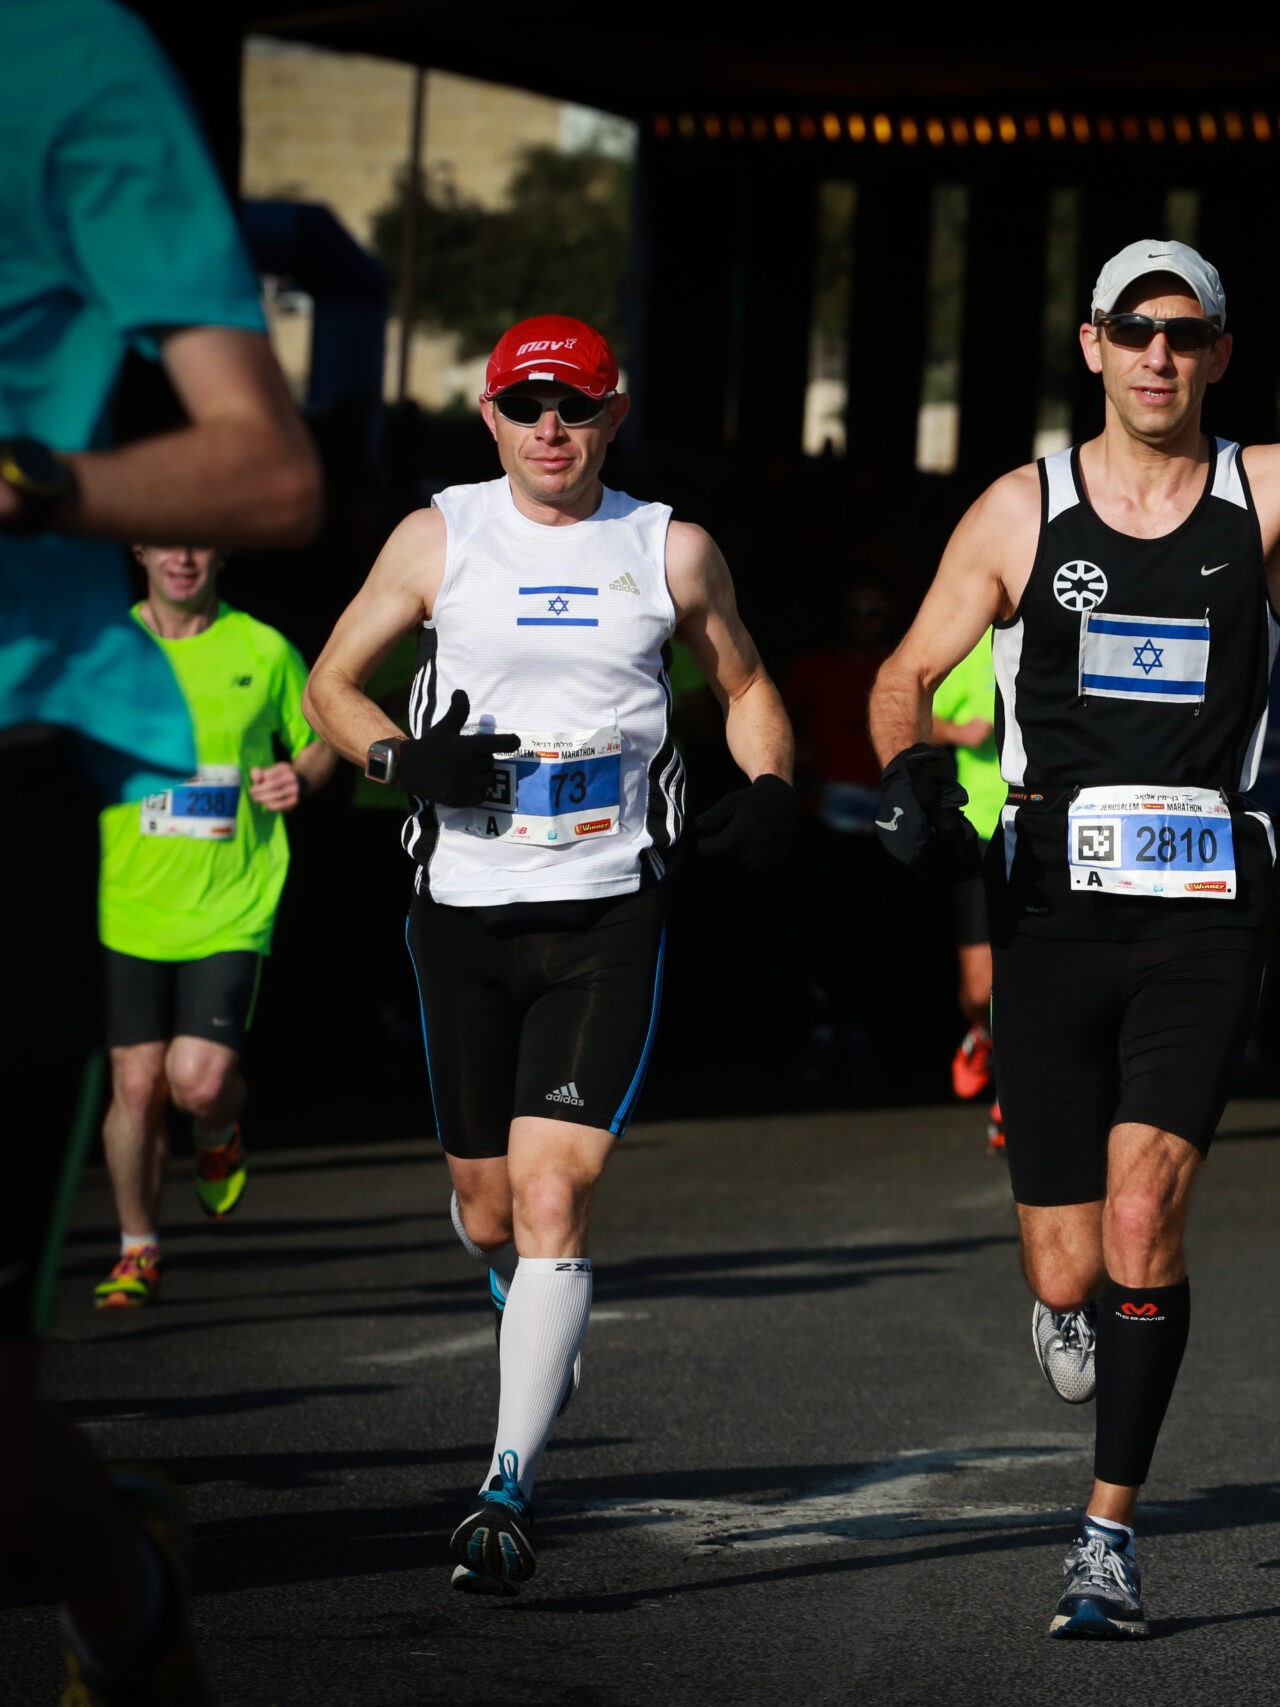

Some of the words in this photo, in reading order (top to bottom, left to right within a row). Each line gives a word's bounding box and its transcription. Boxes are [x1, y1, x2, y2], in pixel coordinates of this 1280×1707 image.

[609, 583, 640, 596] adidas
[561, 747, 596, 759] MARATHON
[551, 770, 586, 809] 73
[1100, 803, 1140, 811] JERUSALEM
[1167, 803, 1202, 813] MARATHON
[486, 816, 499, 836] A
[582, 822, 609, 832] Winner
[1135, 826, 1217, 863] 2810
[1087, 871, 1103, 887] A
[1194, 882, 1225, 890] Winner
[545, 1093, 585, 1107] adidas
